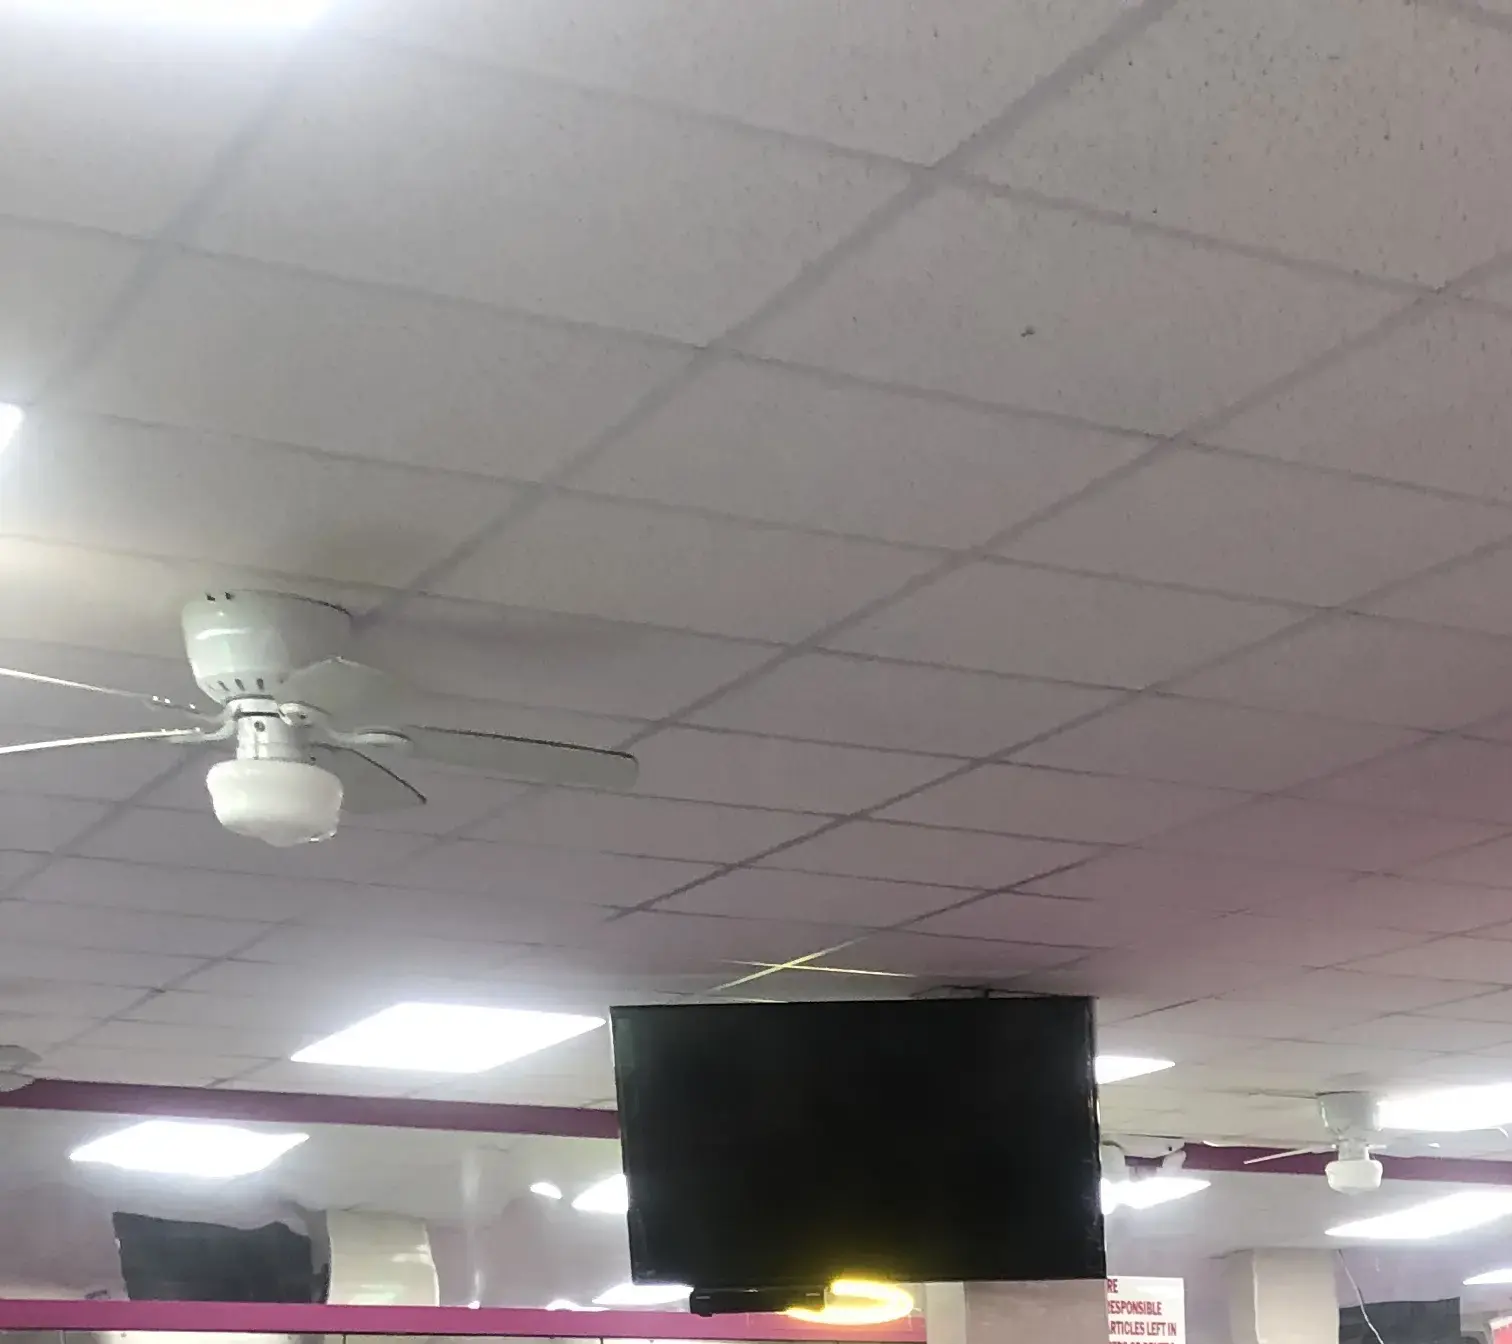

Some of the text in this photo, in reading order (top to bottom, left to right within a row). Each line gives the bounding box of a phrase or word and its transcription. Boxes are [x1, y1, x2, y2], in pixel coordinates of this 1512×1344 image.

[1107, 1278, 1118, 1293] RE
[1108, 1300, 1162, 1315] ESPONSIBLE
[1109, 1320, 1145, 1335] RTICLES
